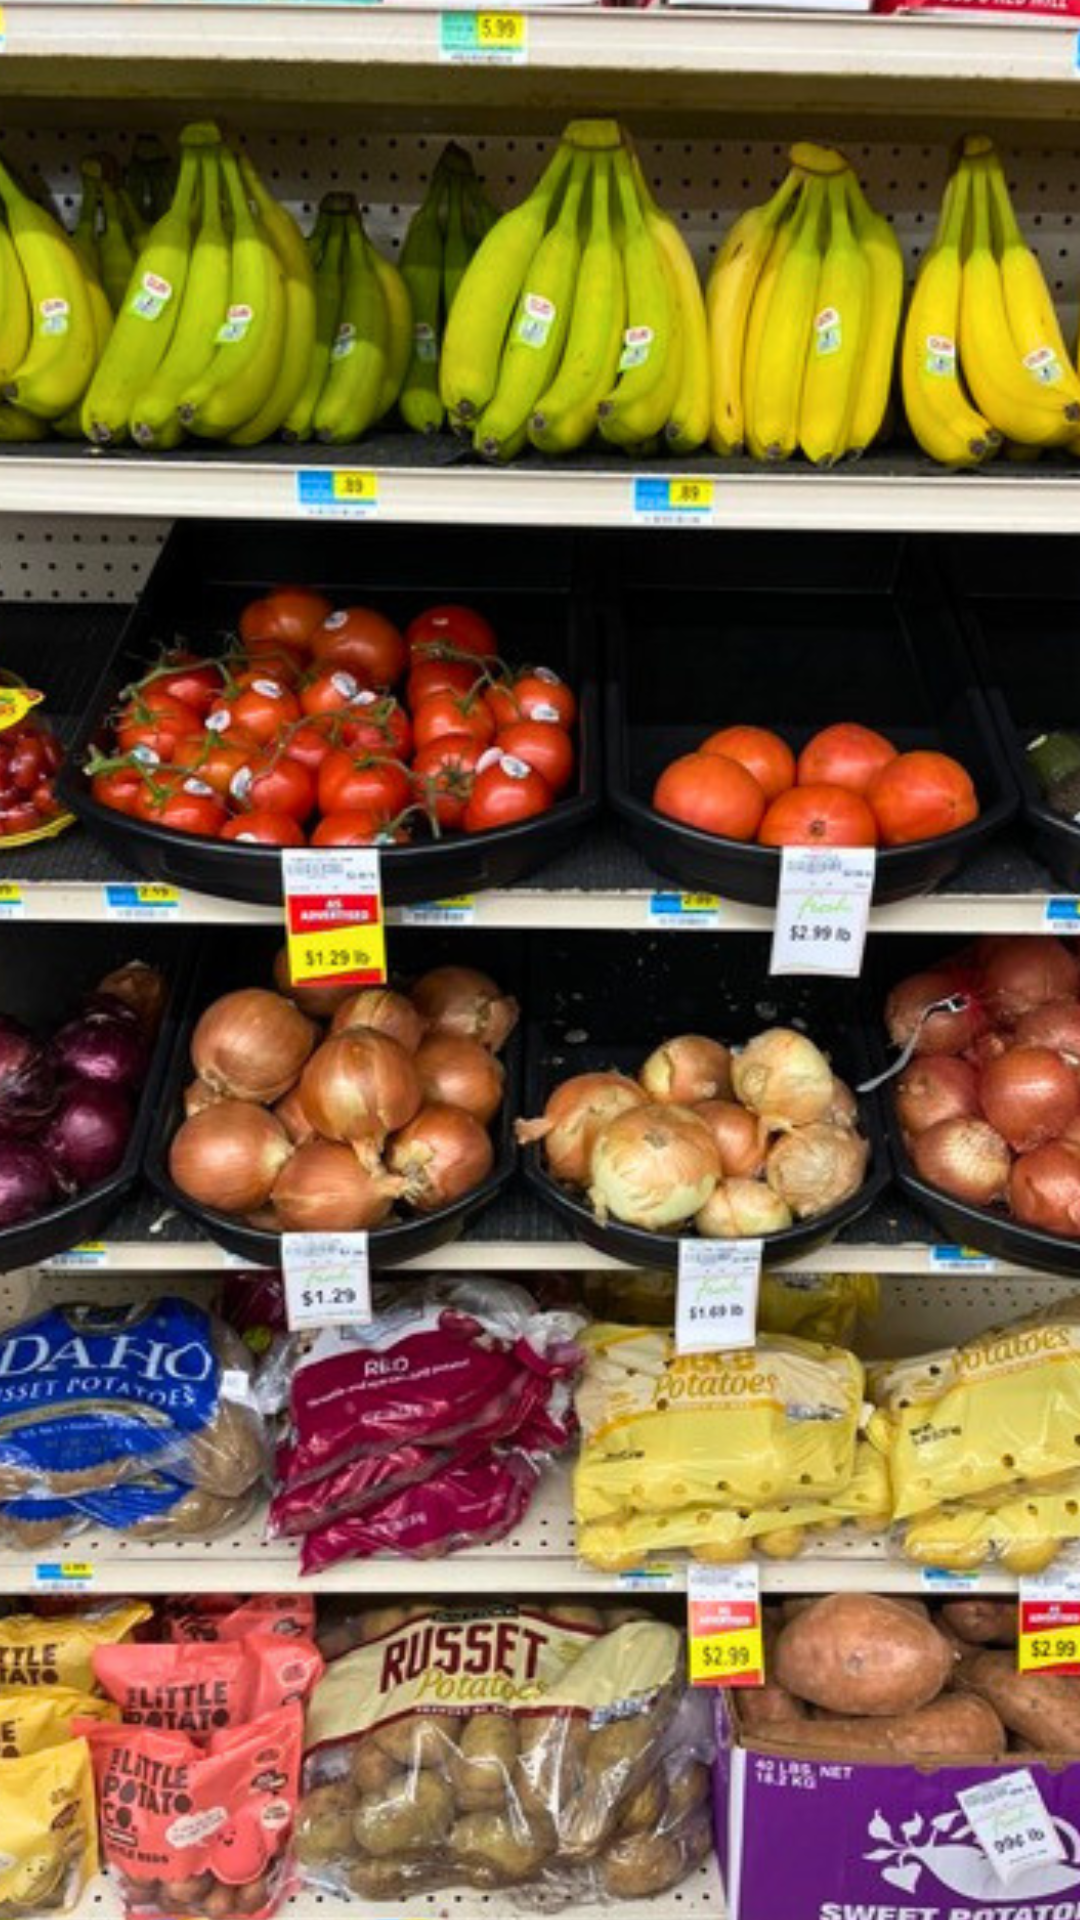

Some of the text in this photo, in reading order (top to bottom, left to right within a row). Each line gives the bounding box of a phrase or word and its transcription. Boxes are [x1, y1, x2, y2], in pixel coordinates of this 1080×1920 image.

[482, 17, 516, 38] 5.99
[790, 924, 851, 942] $2.99 lb
[305, 950, 371, 966] $1.29 lb
[301, 1287, 356, 1307] $1.29
[67, 1377, 196, 1406] POTATOES
[653, 1372, 779, 1401] Potatoes
[380, 1622, 548, 1694] RUSSET
[703, 1645, 749, 1667] $2.99
[1031, 1638, 1076, 1659] $2.99
[415, 1667, 548, 1702] Potatoes
[122, 1708, 230, 1731] POTATO
[791, 1773, 817, 1790] KG
[820, 1765, 854, 1780] NET
[103, 1774, 193, 1816] POTATO
